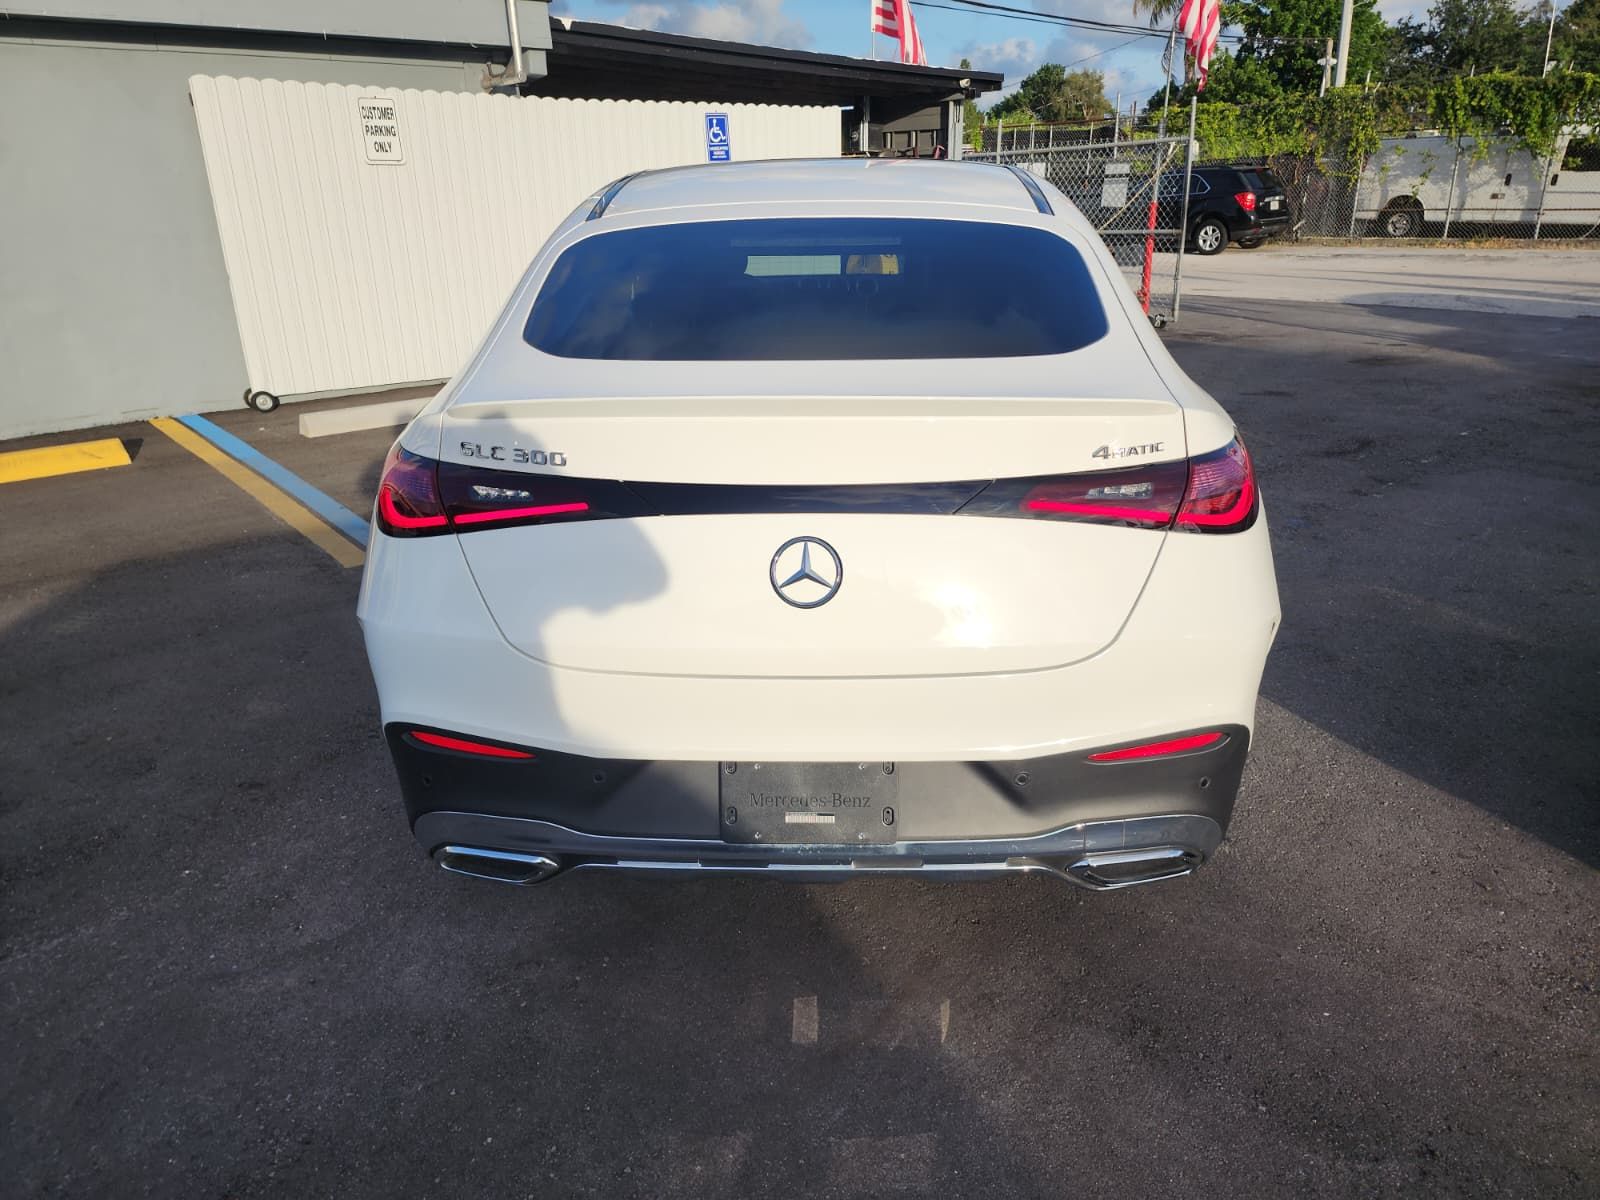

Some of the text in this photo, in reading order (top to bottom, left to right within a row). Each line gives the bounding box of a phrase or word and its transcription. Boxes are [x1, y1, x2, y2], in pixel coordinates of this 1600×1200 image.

[361, 106, 394, 120] CUSTOMER
[365, 125, 396, 136] PARKING
[374, 141, 392, 152] ONLY
[460, 441, 567, 466] GLC 300
